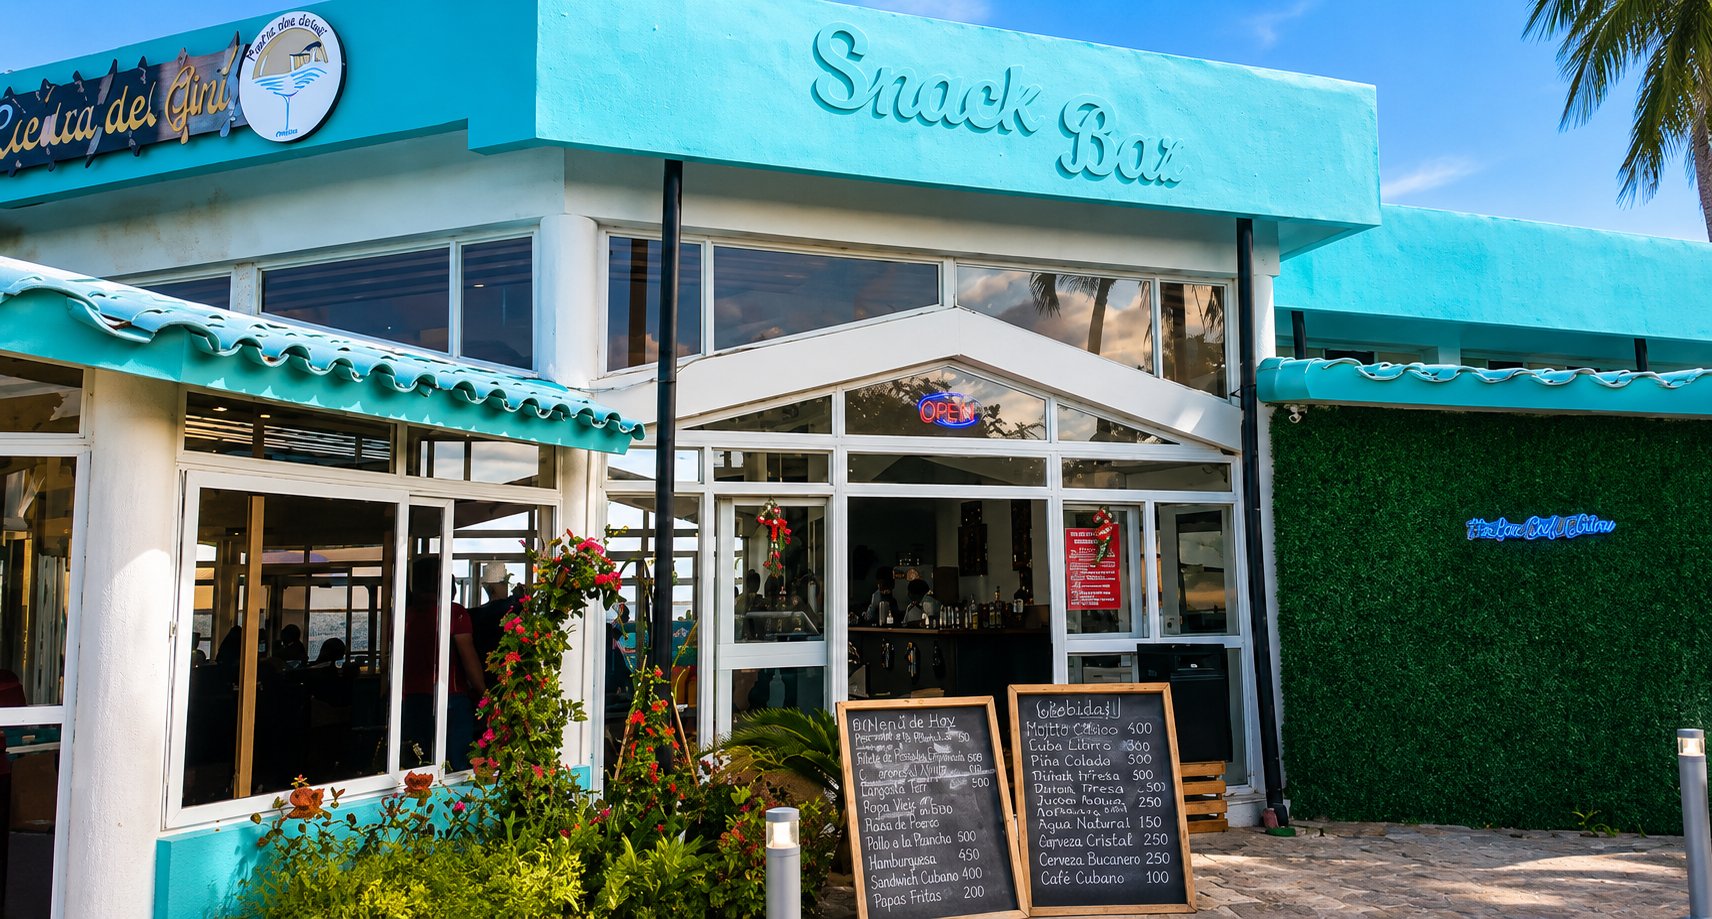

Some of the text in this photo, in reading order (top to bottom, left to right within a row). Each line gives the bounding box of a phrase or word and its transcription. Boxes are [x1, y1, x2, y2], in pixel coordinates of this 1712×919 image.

[811, 22, 1194, 189] Snack Bar
[920, 400, 975, 423] OPEN
[909, 714, 924, 729] de
[928, 713, 956, 730] Hoy
[1029, 739, 1062, 751] Cuba
[1064, 754, 1111, 767] Colada
[1139, 797, 1162, 808] 250
[1039, 816, 1162, 835] Agua Natural 150
[866, 836, 890, 850] Pollo
[901, 835, 912, 848] la
[957, 830, 977, 842] 500
[1086, 833, 1133, 847] Cristal
[1143, 833, 1168, 846] 250
[868, 853, 937, 871] Hamburguesa
[1039, 851, 1170, 867] Cerveza Bucanero 250
[871, 867, 982, 890] Sandwich Cubano 400
[1041, 870, 1169, 885] Café Cubano 100
[873, 886, 985, 912] Papas Fritas 200
